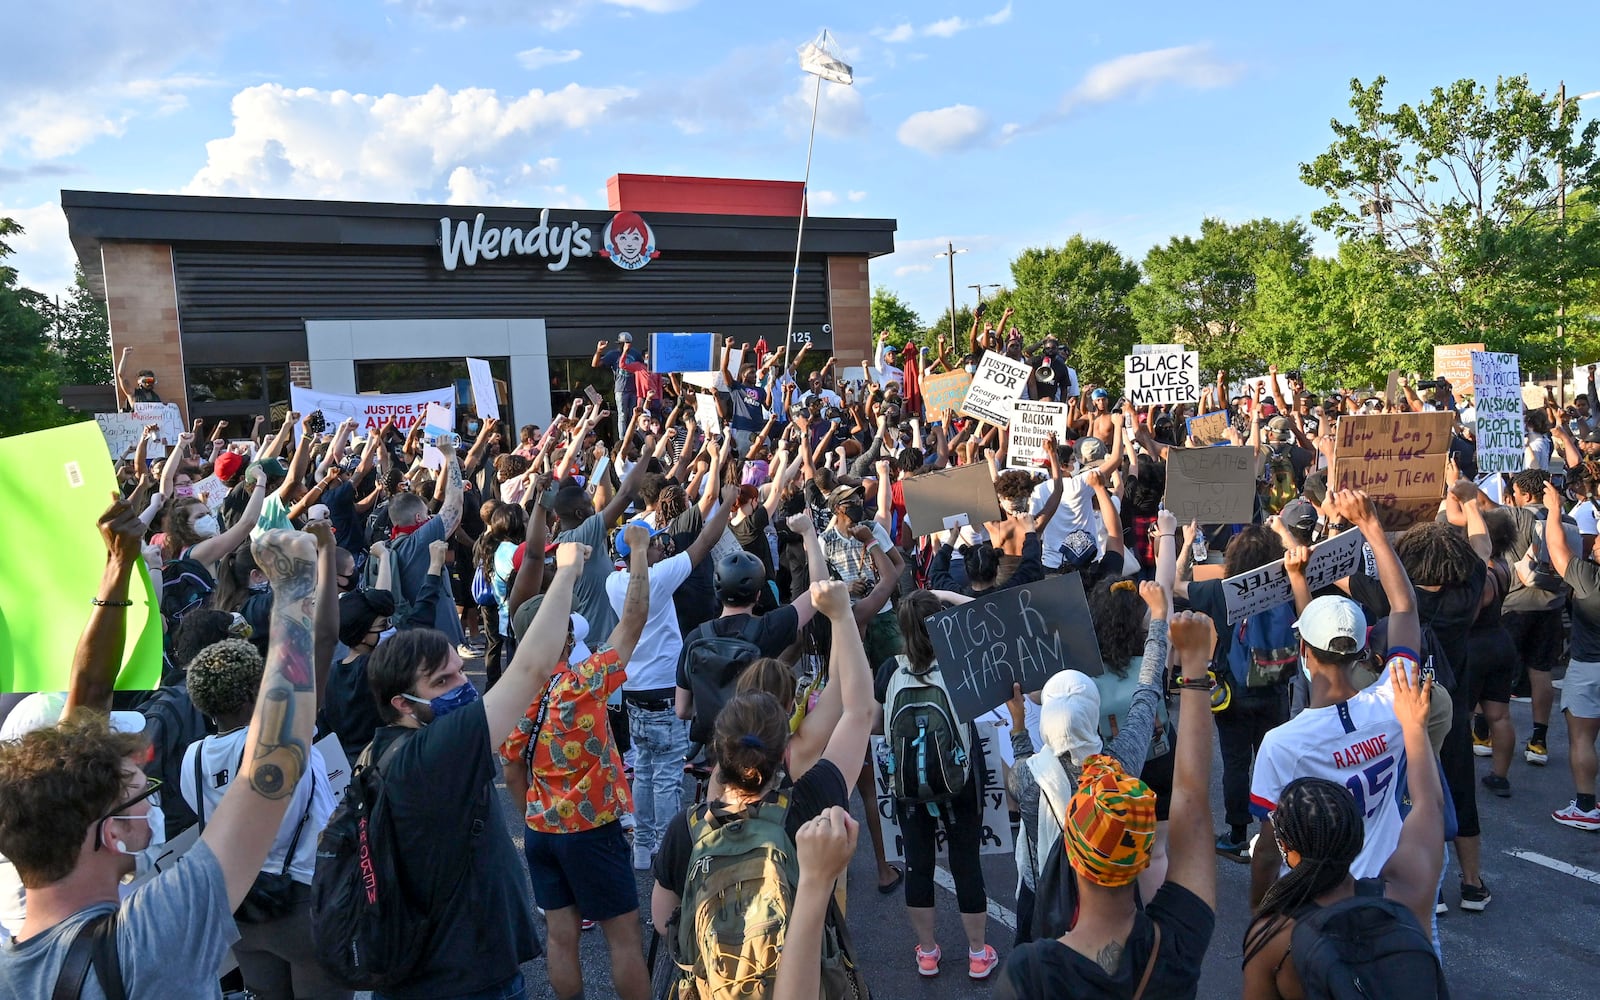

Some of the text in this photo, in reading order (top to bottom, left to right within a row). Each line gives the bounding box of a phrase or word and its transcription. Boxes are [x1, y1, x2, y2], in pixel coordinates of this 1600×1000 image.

[439, 208, 592, 271] Wendy's
[791, 332, 811, 343] 125
[983, 357, 1028, 379] JUSTICE
[1129, 354, 1193, 373] BLACK
[1497, 354, 1514, 364] NOT
[984, 369, 1017, 390] FOR
[1140, 371, 1190, 388] LIVES
[968, 393, 992, 407] Floyd
[972, 385, 1001, 401] George
[1131, 385, 1197, 403] MATTER
[364, 404, 412, 414] JUSTICE
[1476, 397, 1520, 413] MESSAGE
[1014, 424, 1019, 432] is
[1021, 425, 1031, 433] the
[1022, 413, 1053, 426] RACISM
[1477, 417, 1521, 434] PEOPLE
[1343, 421, 1432, 451] How Long
[1394, 469, 1435, 487] THEM
[1230, 564, 1289, 597] FTER
[937, 589, 1048, 660] PIGS R
[957, 629, 1065, 702] HARAM
[1345, 755, 1394, 818] 15
